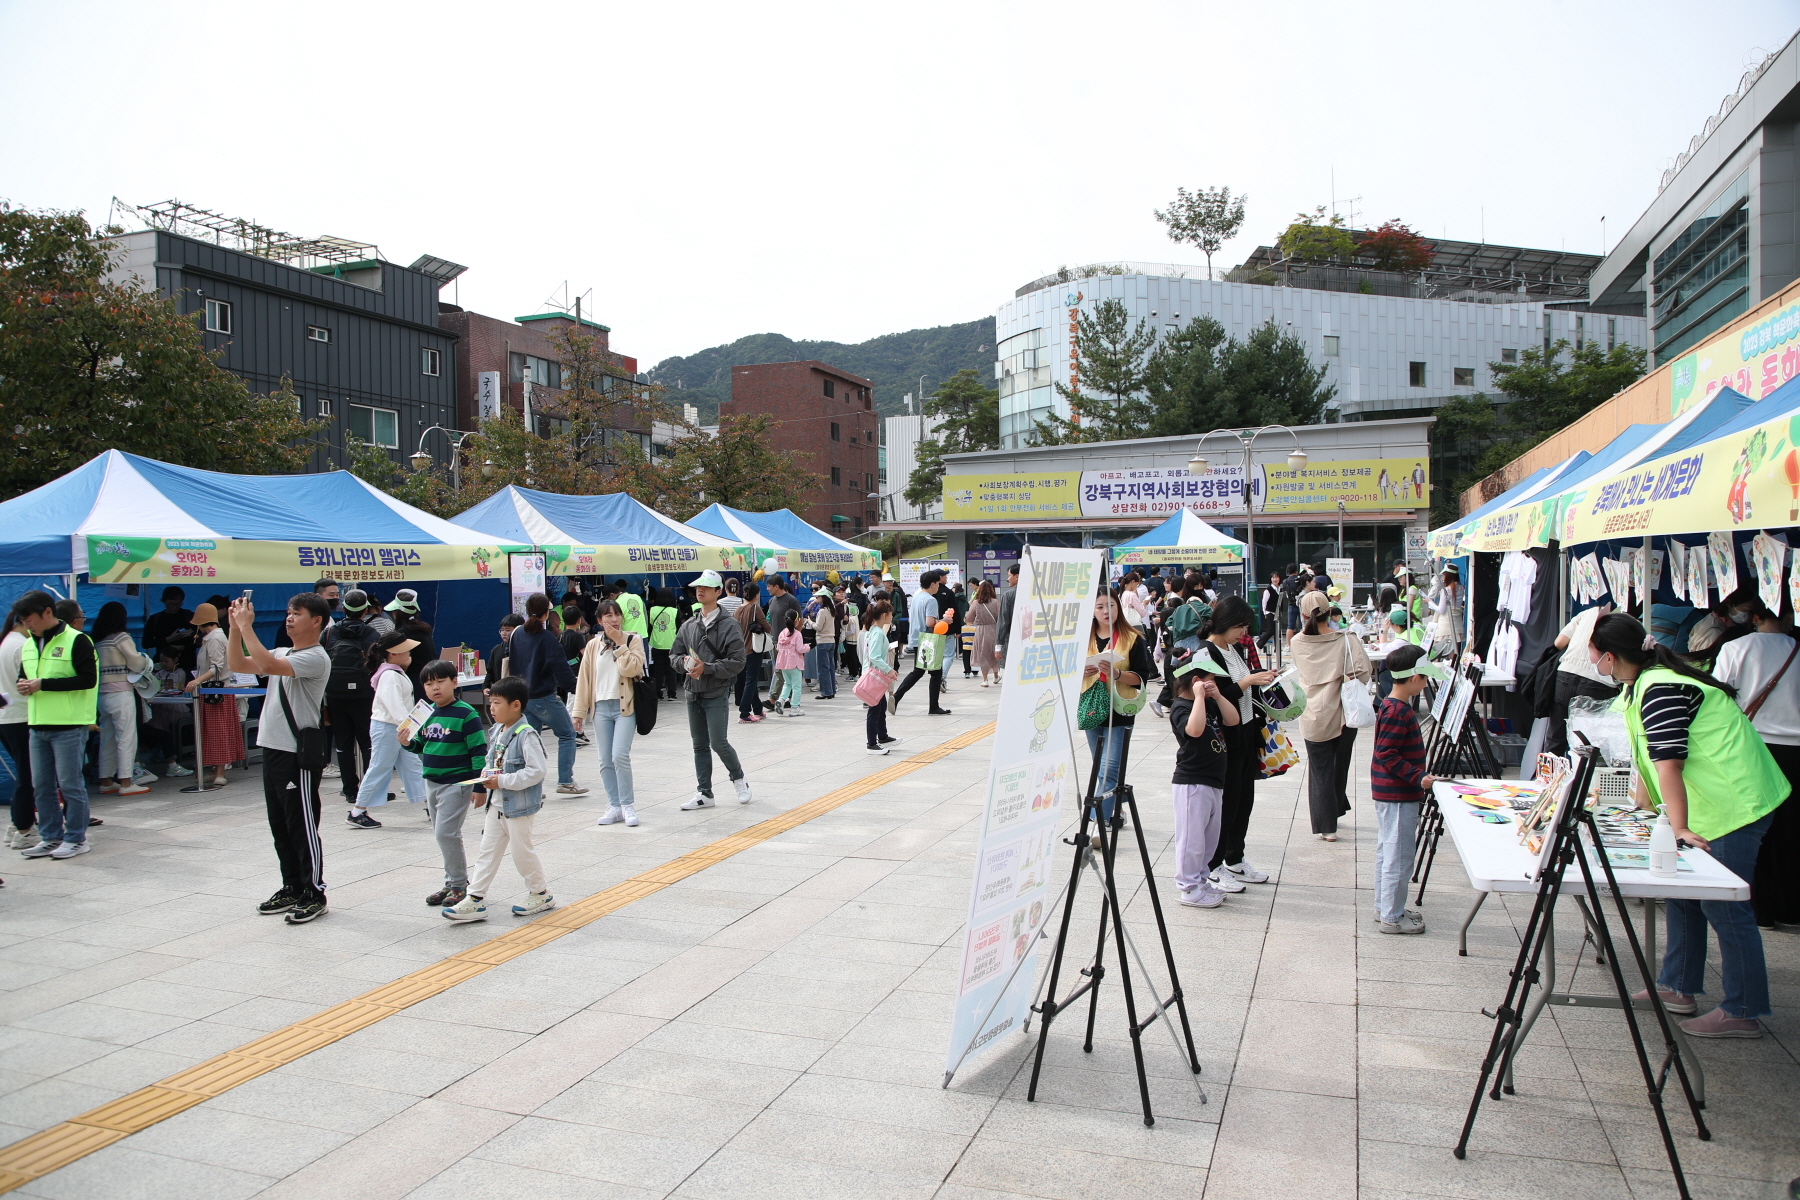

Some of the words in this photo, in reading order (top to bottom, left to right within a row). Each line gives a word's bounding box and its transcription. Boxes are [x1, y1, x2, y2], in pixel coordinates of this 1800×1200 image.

[1129, 471, 1163, 479] 배고프고,
[1300, 469, 1338, 478] 복지서비스
[1341, 467, 1372, 477] 정보제공
[1275, 483, 1305, 491] 자원발굴
[1308, 482, 1316, 491] 및
[1592, 476, 1630, 516] 강북에서
[1620, 470, 1655, 509] 만나는
[1648, 453, 1704, 502] 세계문화
[1018, 492, 1032, 501] 상담
[1111, 503, 1148, 514] 상담전화
[298, 546, 377, 567] 동화나라의
[378, 547, 422, 567] 앨리스
[628, 547, 661, 562] 향기나는
[661, 548, 677, 561] 바다
[677, 548, 699, 561] 만들기
[170, 565, 204, 577] 동화의
[206, 565, 217, 577] 숲
